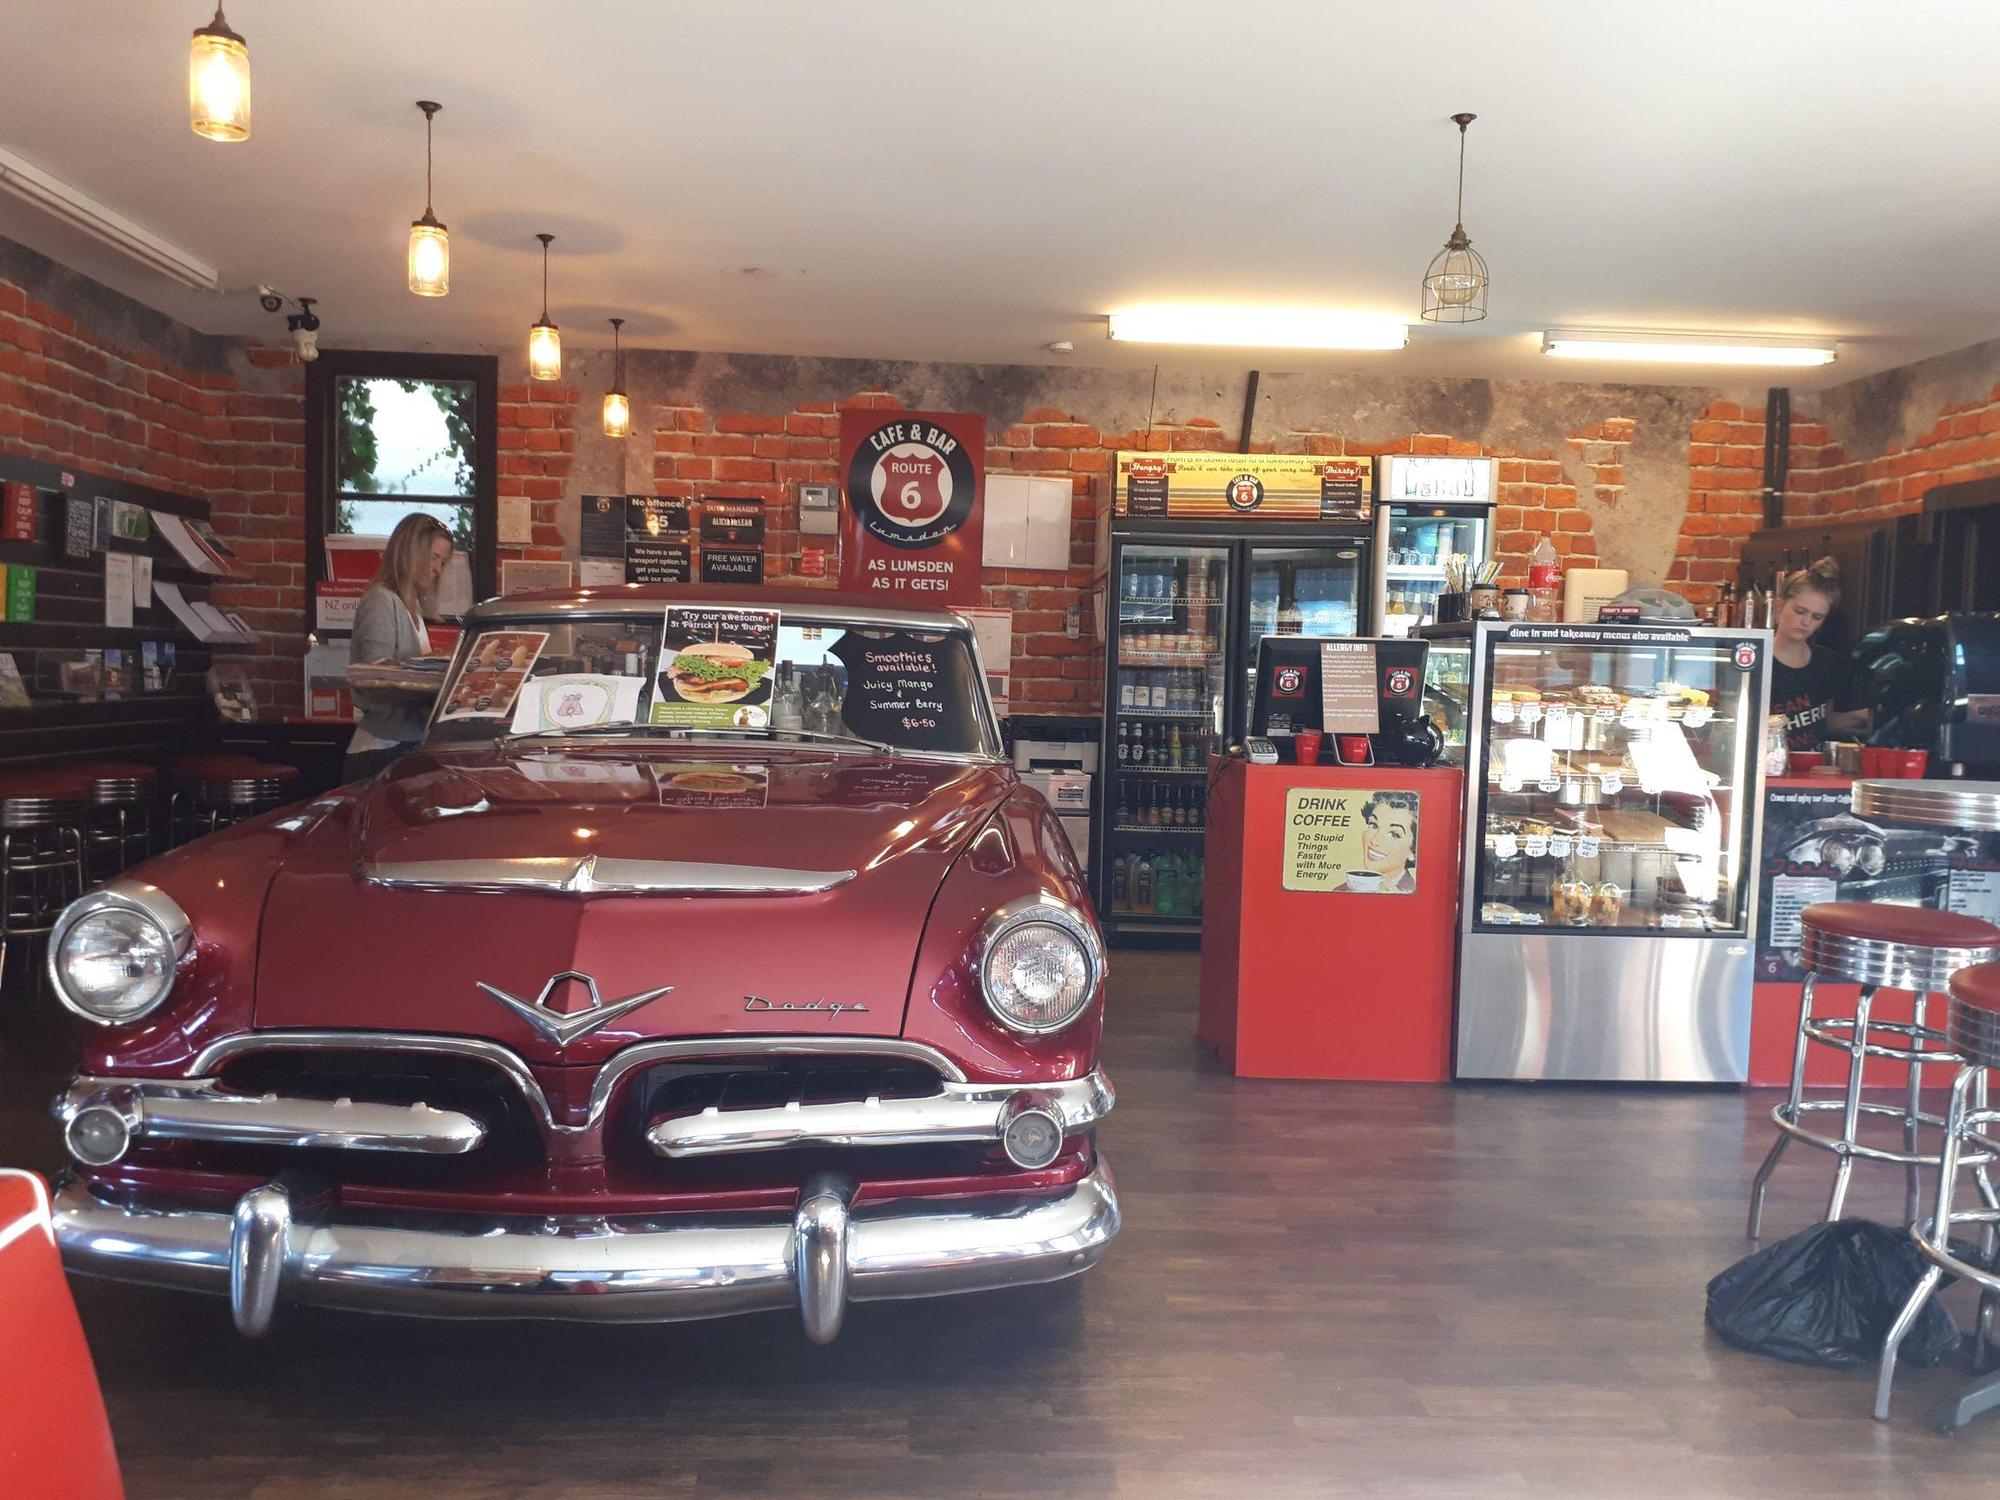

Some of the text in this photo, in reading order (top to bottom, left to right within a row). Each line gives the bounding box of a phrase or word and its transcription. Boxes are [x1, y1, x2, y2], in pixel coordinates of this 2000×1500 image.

[870, 424, 957, 455] CAFE & BAR
[892, 462, 932, 474] ROUTE
[901, 481, 921, 509] 6
[1241, 492, 1248, 500] 6
[632, 498, 645, 506] No
[726, 504, 759, 513] MANAGER
[629, 557, 658, 565] transport
[868, 560, 954, 573] AS LUMSDEN
[872, 578, 949, 590] AS IT GETS!
[325, 600, 340, 609] NZ
[683, 611, 699, 620] Try
[722, 622, 739, 630] Day
[742, 623, 773, 632] Burger!
[1510, 628, 1529, 638] dine
[1532, 629, 1540, 638] in
[1542, 629, 1558, 638] and
[1560, 629, 1600, 641] takeaway
[1632, 632, 1649, 640] also
[1651, 632, 1689, 642] available
[865, 651, 932, 663] Smoothies
[877, 663, 938, 673] available!
[864, 679, 933, 692] Juicy Mango
[870, 699, 943, 712] Summer Berry
[1298, 798, 1348, 811] DRINK
[1293, 814, 1351, 827] COFFEE
[1314, 833, 1344, 843] Stupid
[1298, 843, 1328, 852] Things
[1296, 871, 1329, 880] Energy
[1768, 962, 1777, 973] 6
[743, 995, 870, 1020] Dodge
